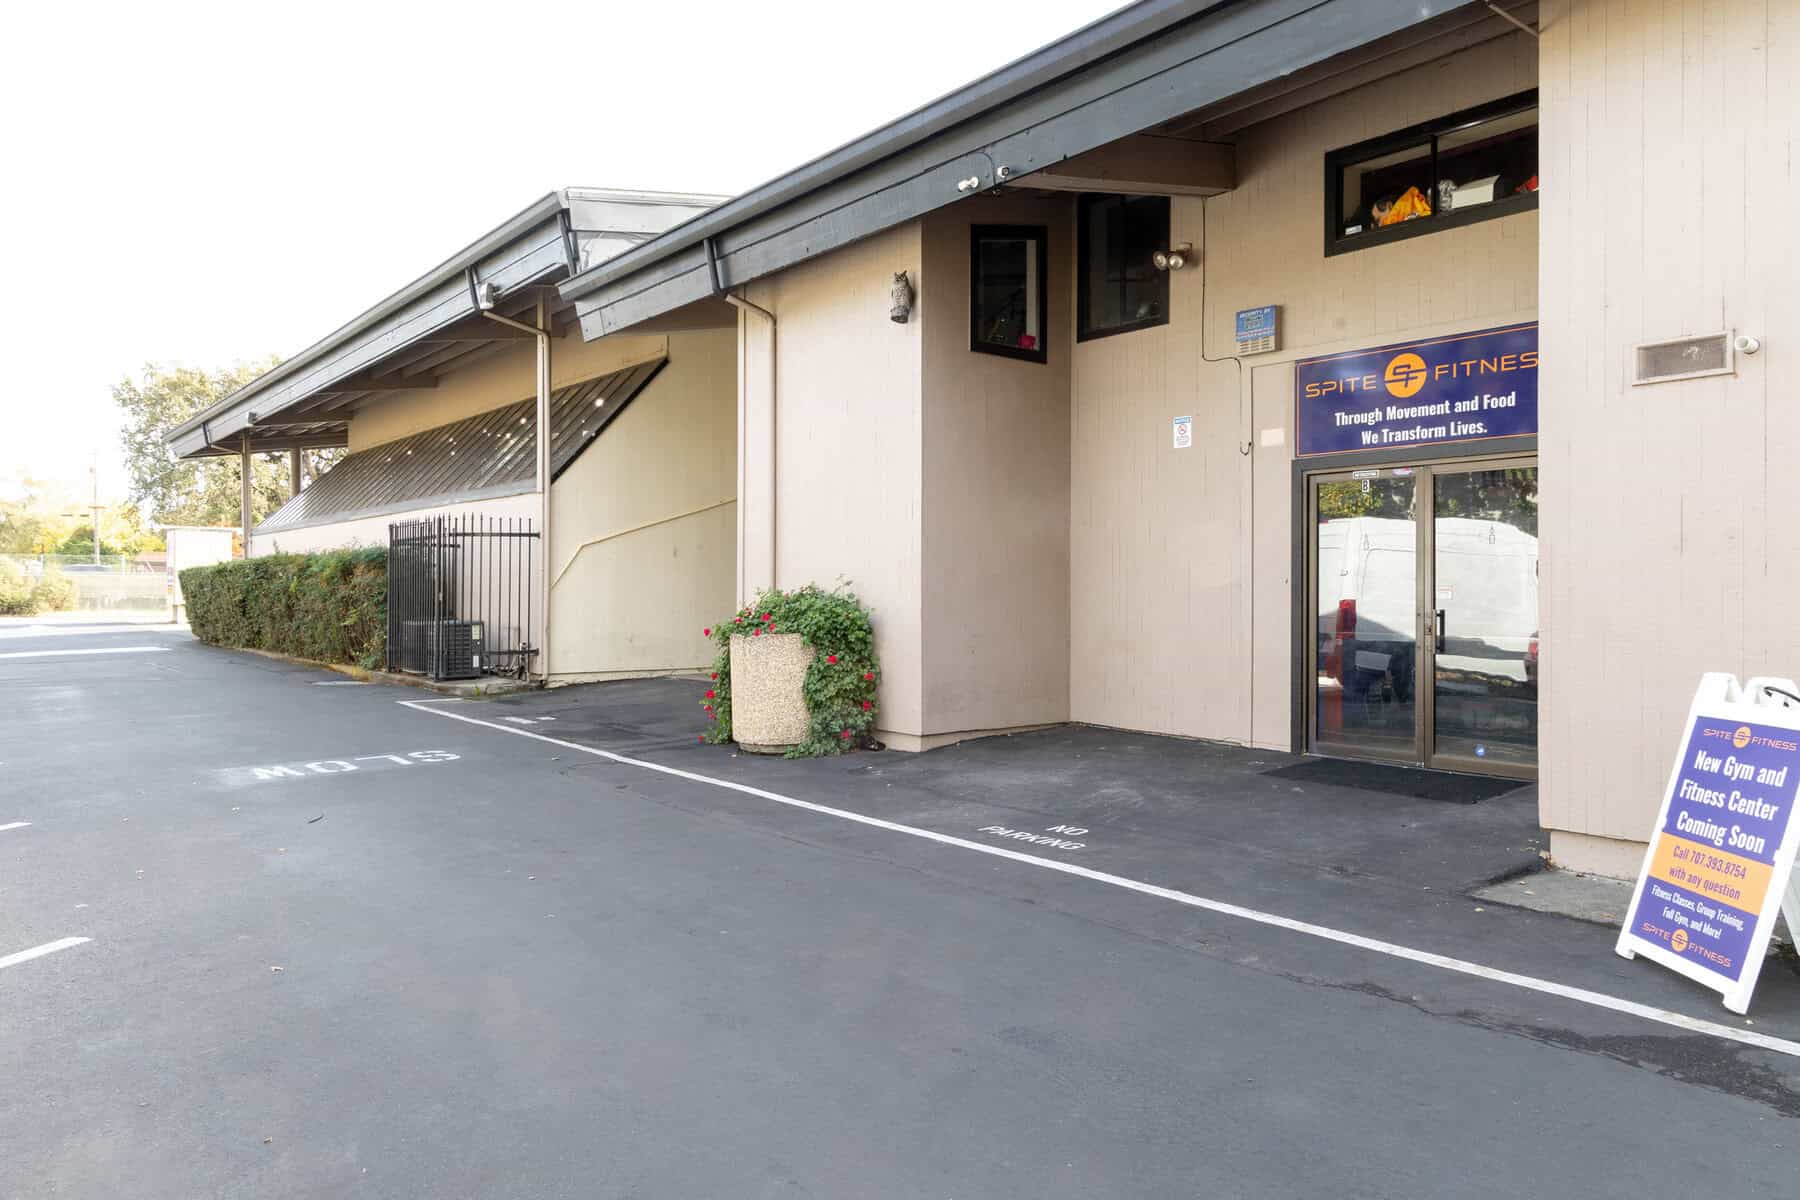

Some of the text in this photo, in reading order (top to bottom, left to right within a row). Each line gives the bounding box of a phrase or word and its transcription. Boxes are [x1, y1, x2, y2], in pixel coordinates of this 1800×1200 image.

[1304, 374, 1377, 398] SPITE
[1434, 351, 1538, 381] FITNES
[1334, 391, 1516, 426] Through Movement and Food
[1361, 421, 1488, 445] We Transform Lives.
[1703, 728, 1733, 740] SPITE
[1751, 735, 1798, 752] FITNESS
[1694, 750, 1788, 788] New Gym and
[1679, 779, 1780, 821] Fitness Center
[977, 825, 1087, 850] PARKING
[1045, 825, 1089, 836] NO
[1676, 810, 1766, 854] Coming Soon
[1673, 845, 1747, 879] Call 707.393.8754
[1669, 866, 1741, 900] with any question
[1651, 884, 1673, 902] Fitness
[1696, 901, 1717, 919] Group
[1662, 906, 1674, 921] Full
[1690, 918, 1703, 932] and
[1702, 921, 1723, 940] More!
[1642, 922, 1671, 941] SPITE
[1688, 942, 1732, 968] FITNESS
